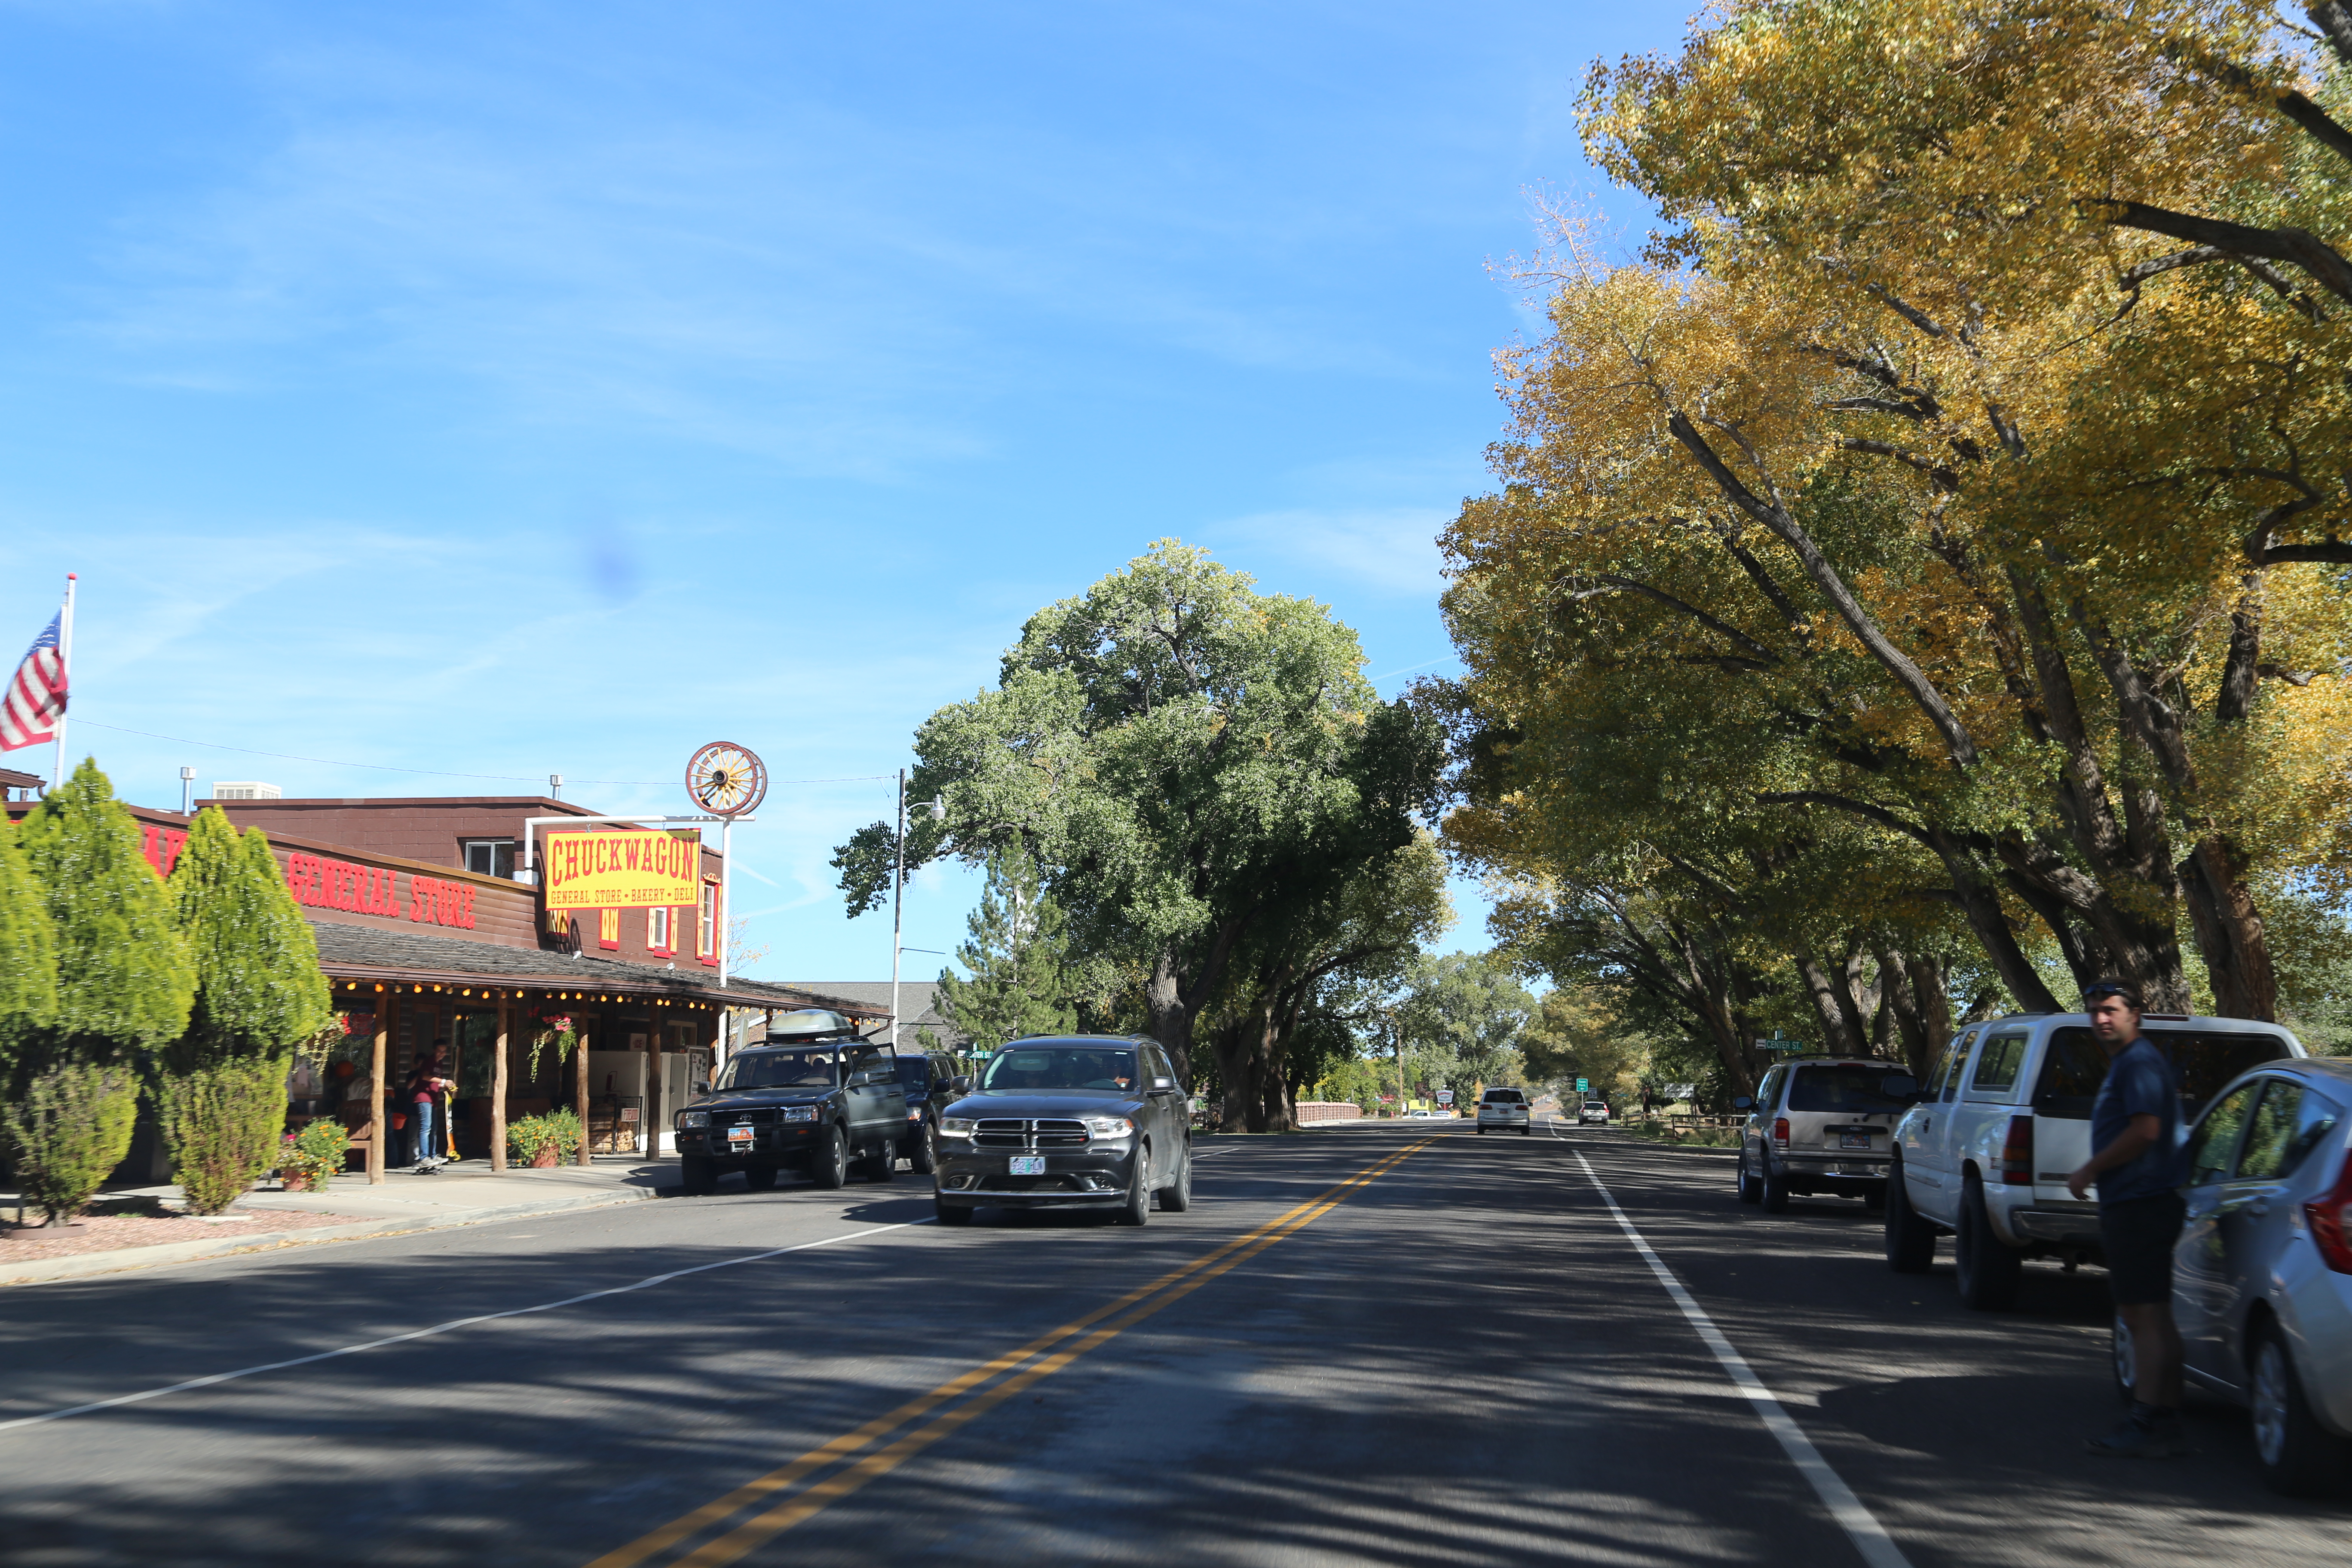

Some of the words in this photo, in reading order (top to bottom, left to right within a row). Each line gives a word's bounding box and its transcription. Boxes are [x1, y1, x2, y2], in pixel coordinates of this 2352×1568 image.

[552, 836, 695, 887] CHUCKWAGON
[287, 852, 400, 917] GENERAL
[409, 875, 476, 929] STORE
[551, 890, 590, 904] GENERAL
[595, 889, 622, 903] STORE
[631, 888, 665, 902] BAKERY
[674, 887, 694, 901] DELI
[1767, 1040, 1790, 1049] CENTER
[1792, 1041, 1801, 1050] ST.
